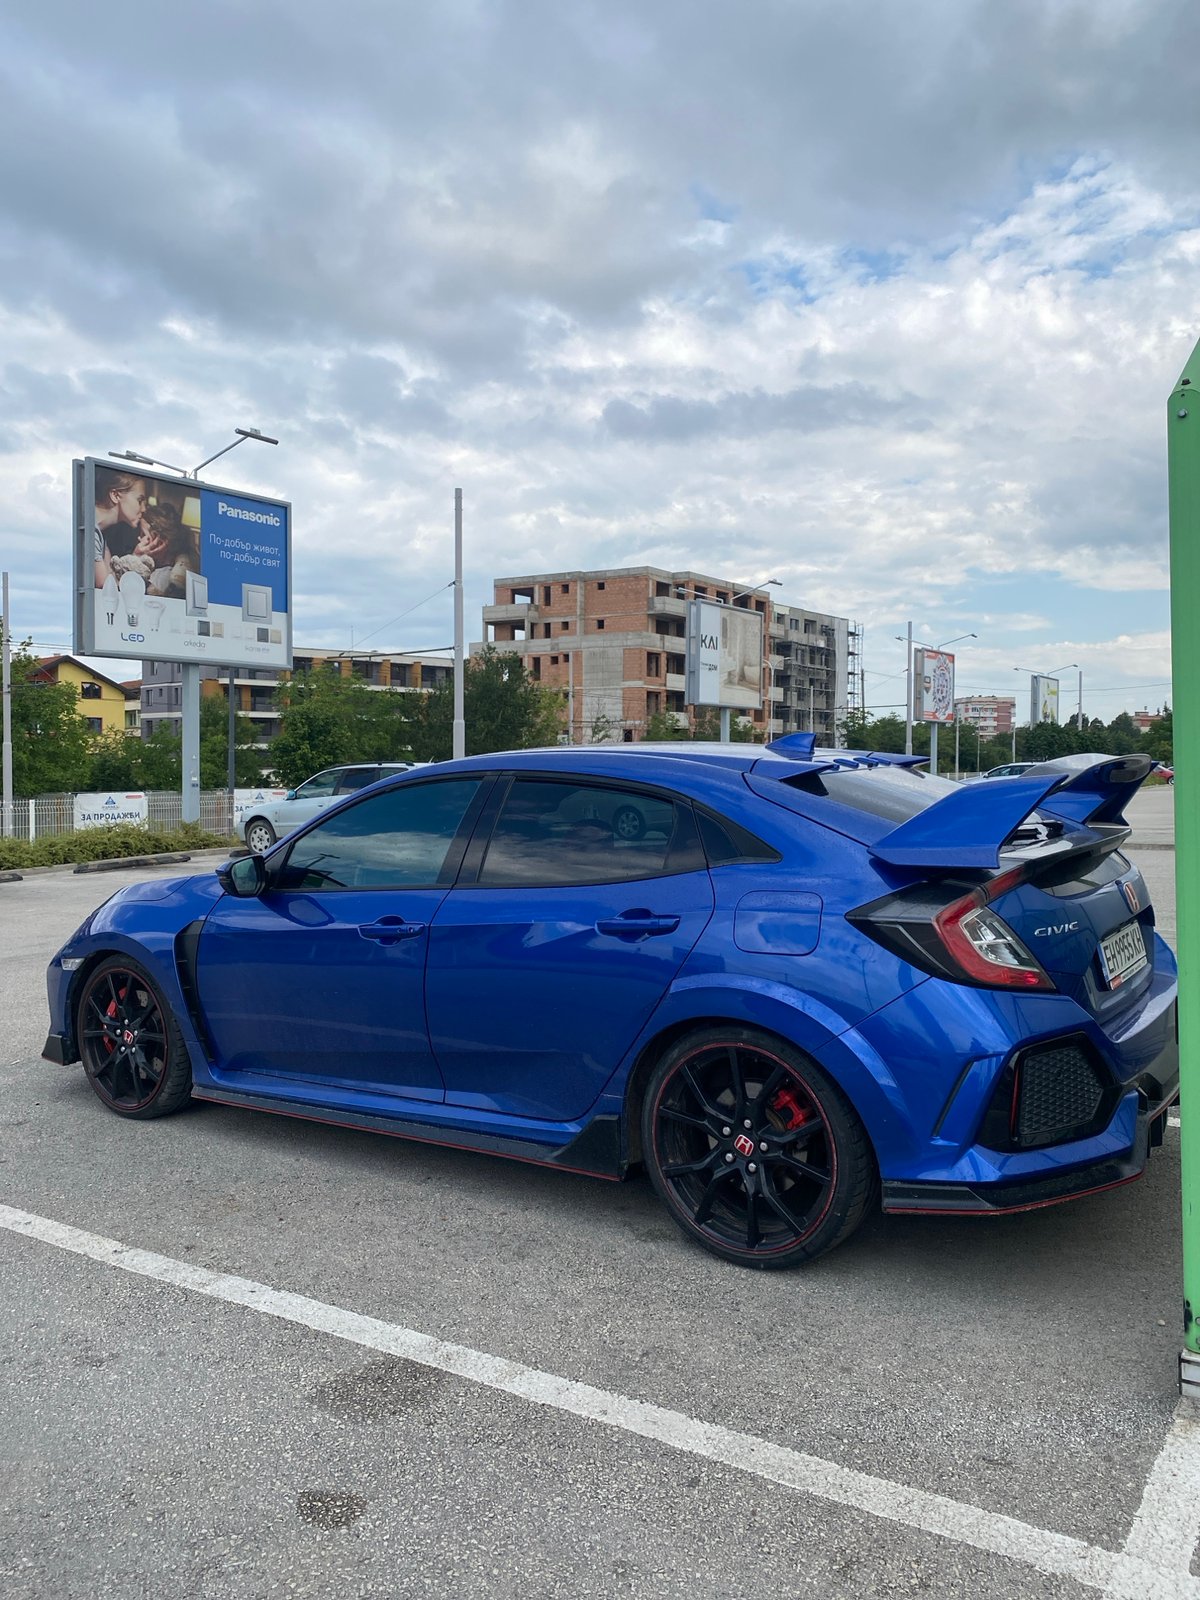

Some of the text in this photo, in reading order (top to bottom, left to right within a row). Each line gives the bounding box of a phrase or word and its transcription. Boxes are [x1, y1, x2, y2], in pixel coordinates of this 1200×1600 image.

[218, 502, 280, 526] Panasonic
[209, 533, 281, 556] По-добър живот,
[220, 550, 280, 567] по-добър свят
[120, 632, 145, 643] LED
[700, 634, 718, 650] KAI
[81, 811, 140, 821] ЗА ПРОДАЖБИ
[1034, 921, 1079, 937] CIVIC
